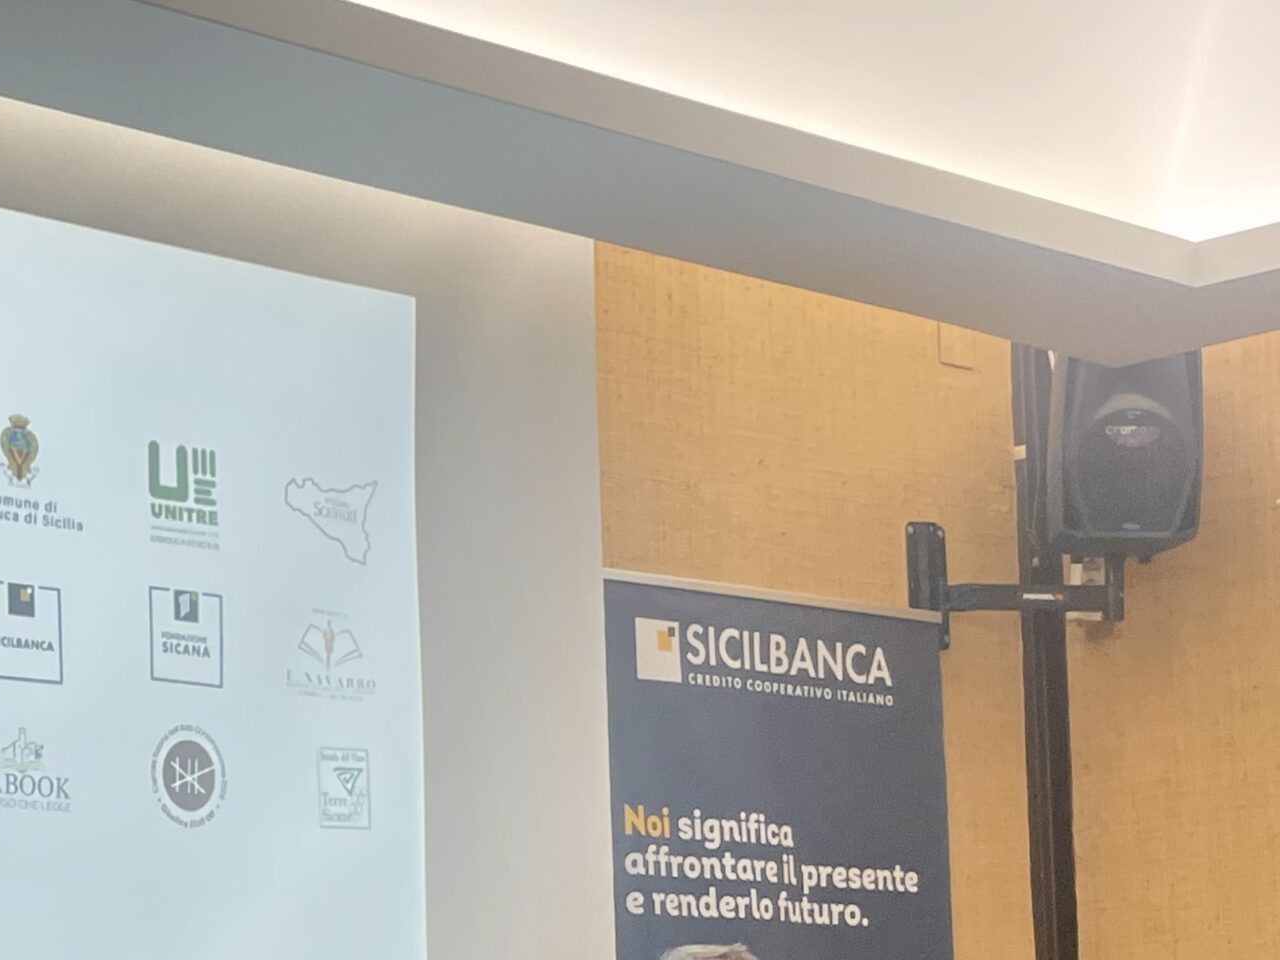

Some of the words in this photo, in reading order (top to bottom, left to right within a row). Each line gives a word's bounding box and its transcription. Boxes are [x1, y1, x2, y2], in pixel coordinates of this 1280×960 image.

[24, 512, 38, 525] di
[42, 514, 84, 532] Sicilia
[45, 501, 57, 513] di
[150, 502, 218, 526] UNITRE
[162, 641, 211, 658] SICANA
[686, 623, 893, 687] SICILBANCA
[689, 673, 741, 689] CREDITO
[747, 679, 832, 700] COOPERATIVO
[837, 689, 894, 706] ITALIANO
[624, 804, 670, 838] Noi
[678, 809, 794, 849] significa
[625, 844, 778, 883] affrontare
[782, 854, 797, 886] il
[801, 865, 919, 894] presente
[626, 890, 645, 914] e
[652, 887, 773, 921] renderlo
[778, 892, 869, 927] futuro.
